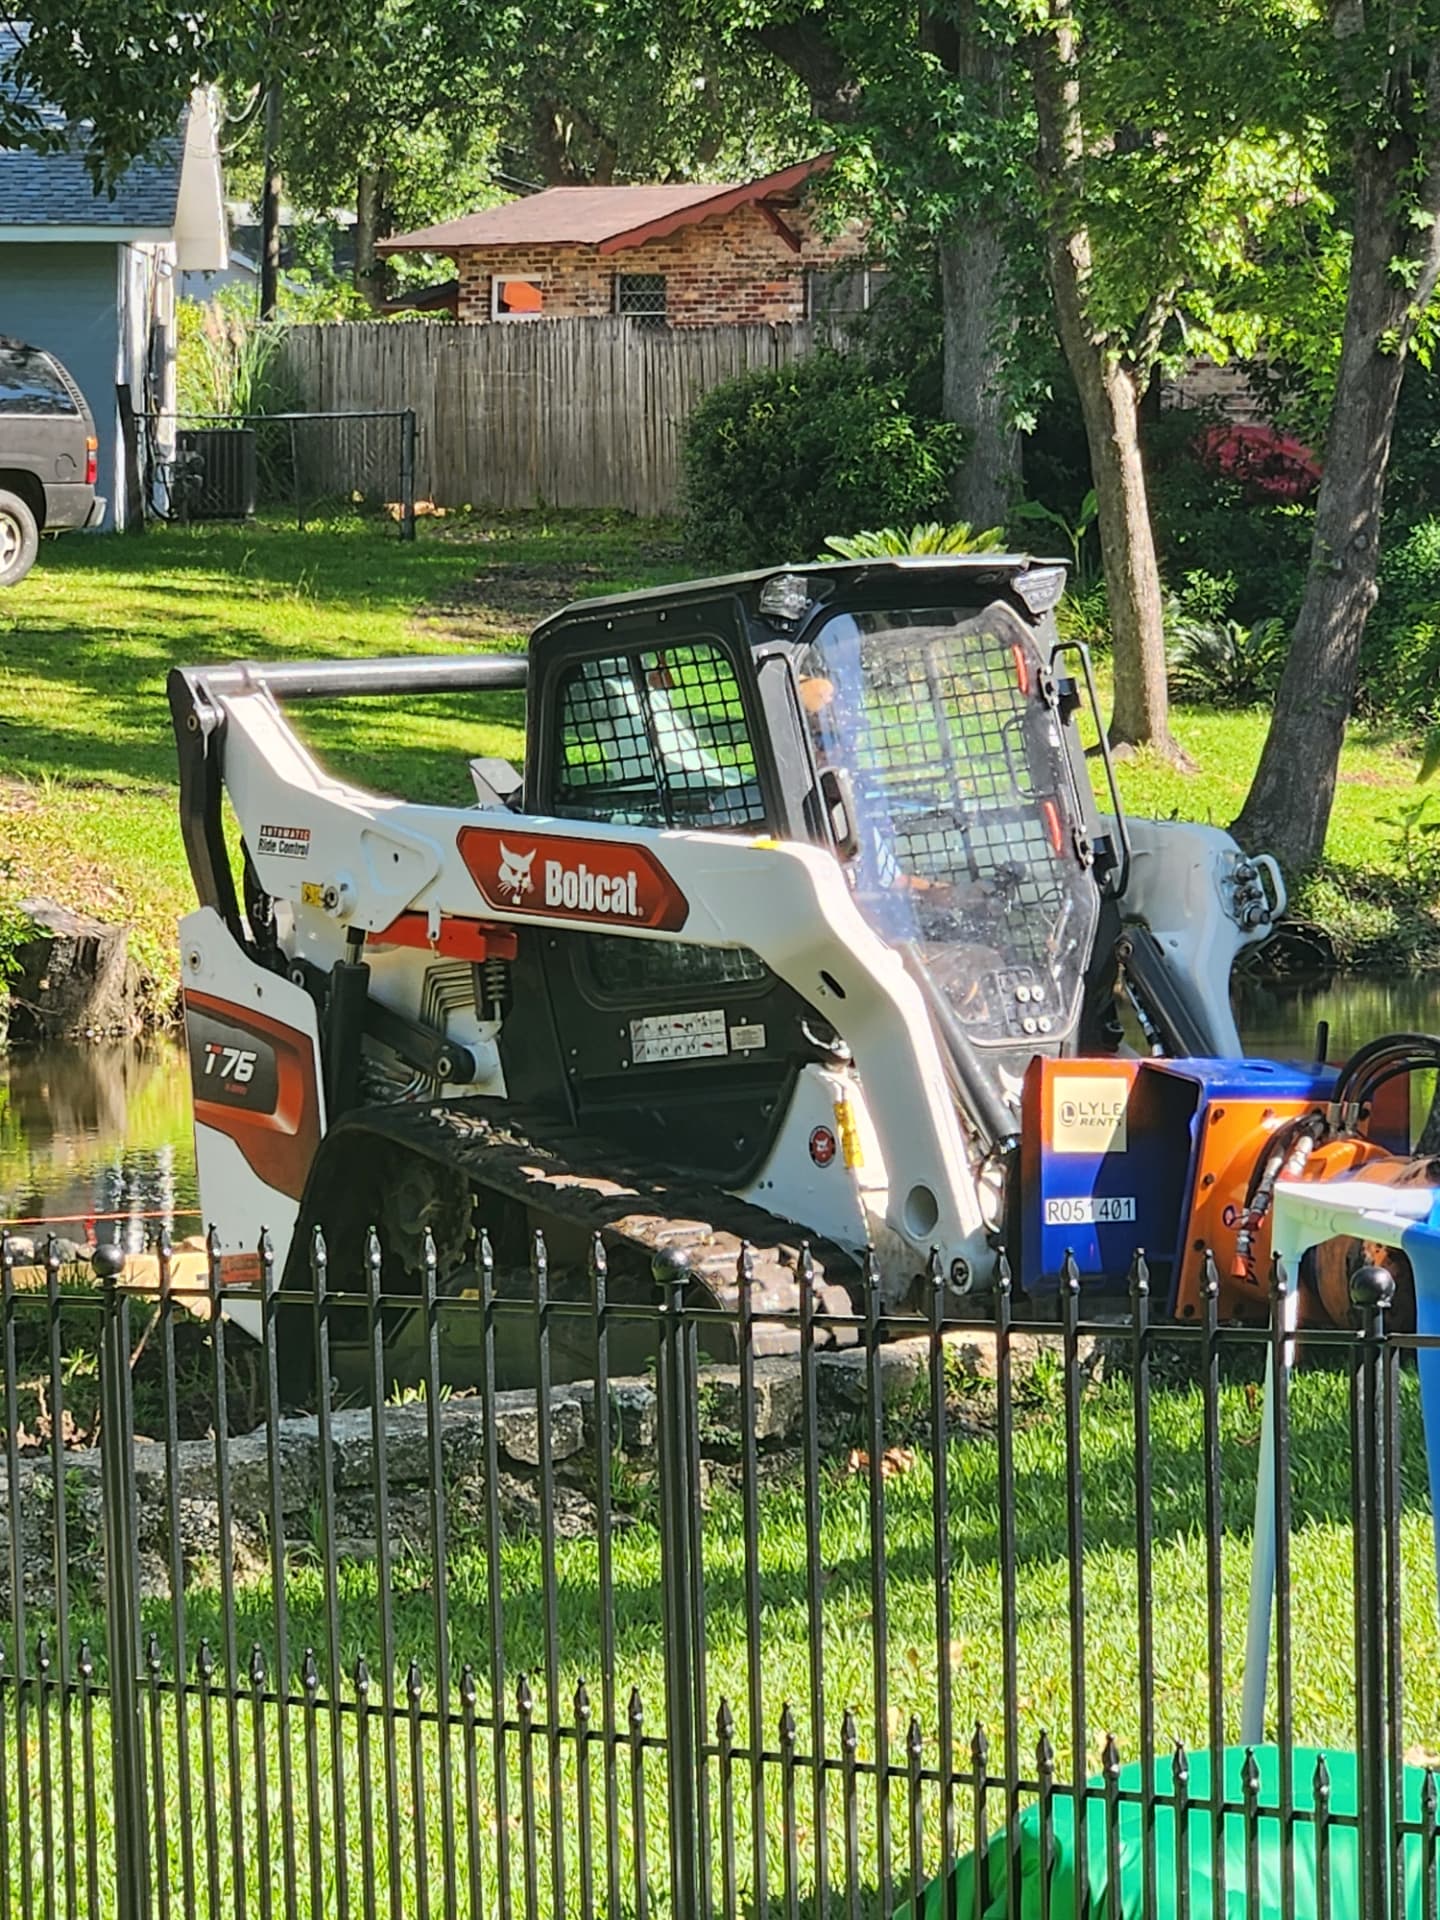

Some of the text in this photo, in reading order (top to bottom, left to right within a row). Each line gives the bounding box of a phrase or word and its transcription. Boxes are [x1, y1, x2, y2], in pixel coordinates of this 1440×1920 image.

[261, 825, 310, 841] AUTOMATIC
[258, 838, 310, 856] Ride Control
[545, 860, 638, 916] Bobcat
[204, 1043, 257, 1082] T76
[1079, 1102, 1122, 1116] LYLE
[1080, 1117, 1123, 1128] RENTS
